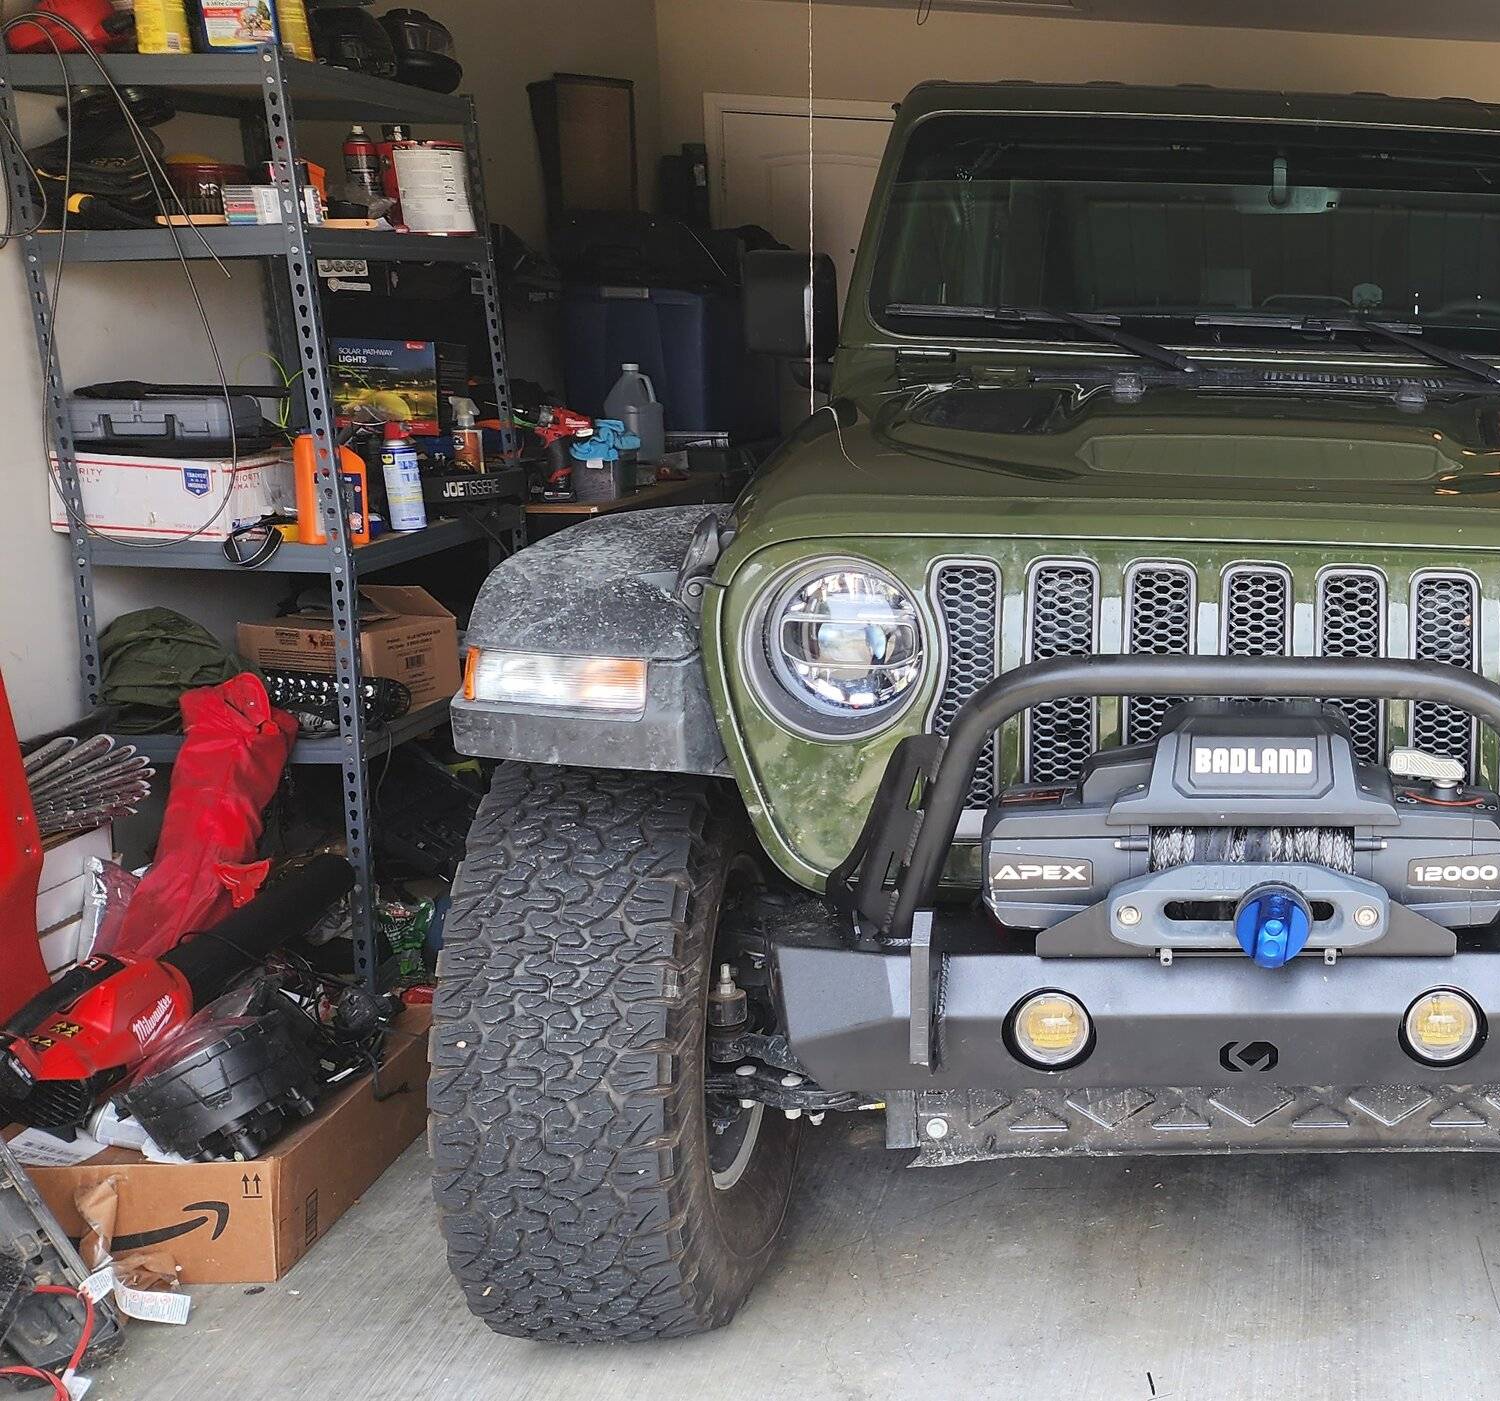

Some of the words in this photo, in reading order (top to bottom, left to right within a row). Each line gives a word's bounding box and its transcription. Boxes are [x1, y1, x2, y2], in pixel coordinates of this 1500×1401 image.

[338, 347, 361, 355] SOLAR
[362, 348, 394, 357] PATHWAY
[338, 355, 368, 364] LIGHTS
[1194, 747, 1313, 774] BADLAND
[994, 865, 1087, 881] APEX
[1414, 865, 1499, 882] 12000
[132, 994, 172, 1044] Milwaukee
